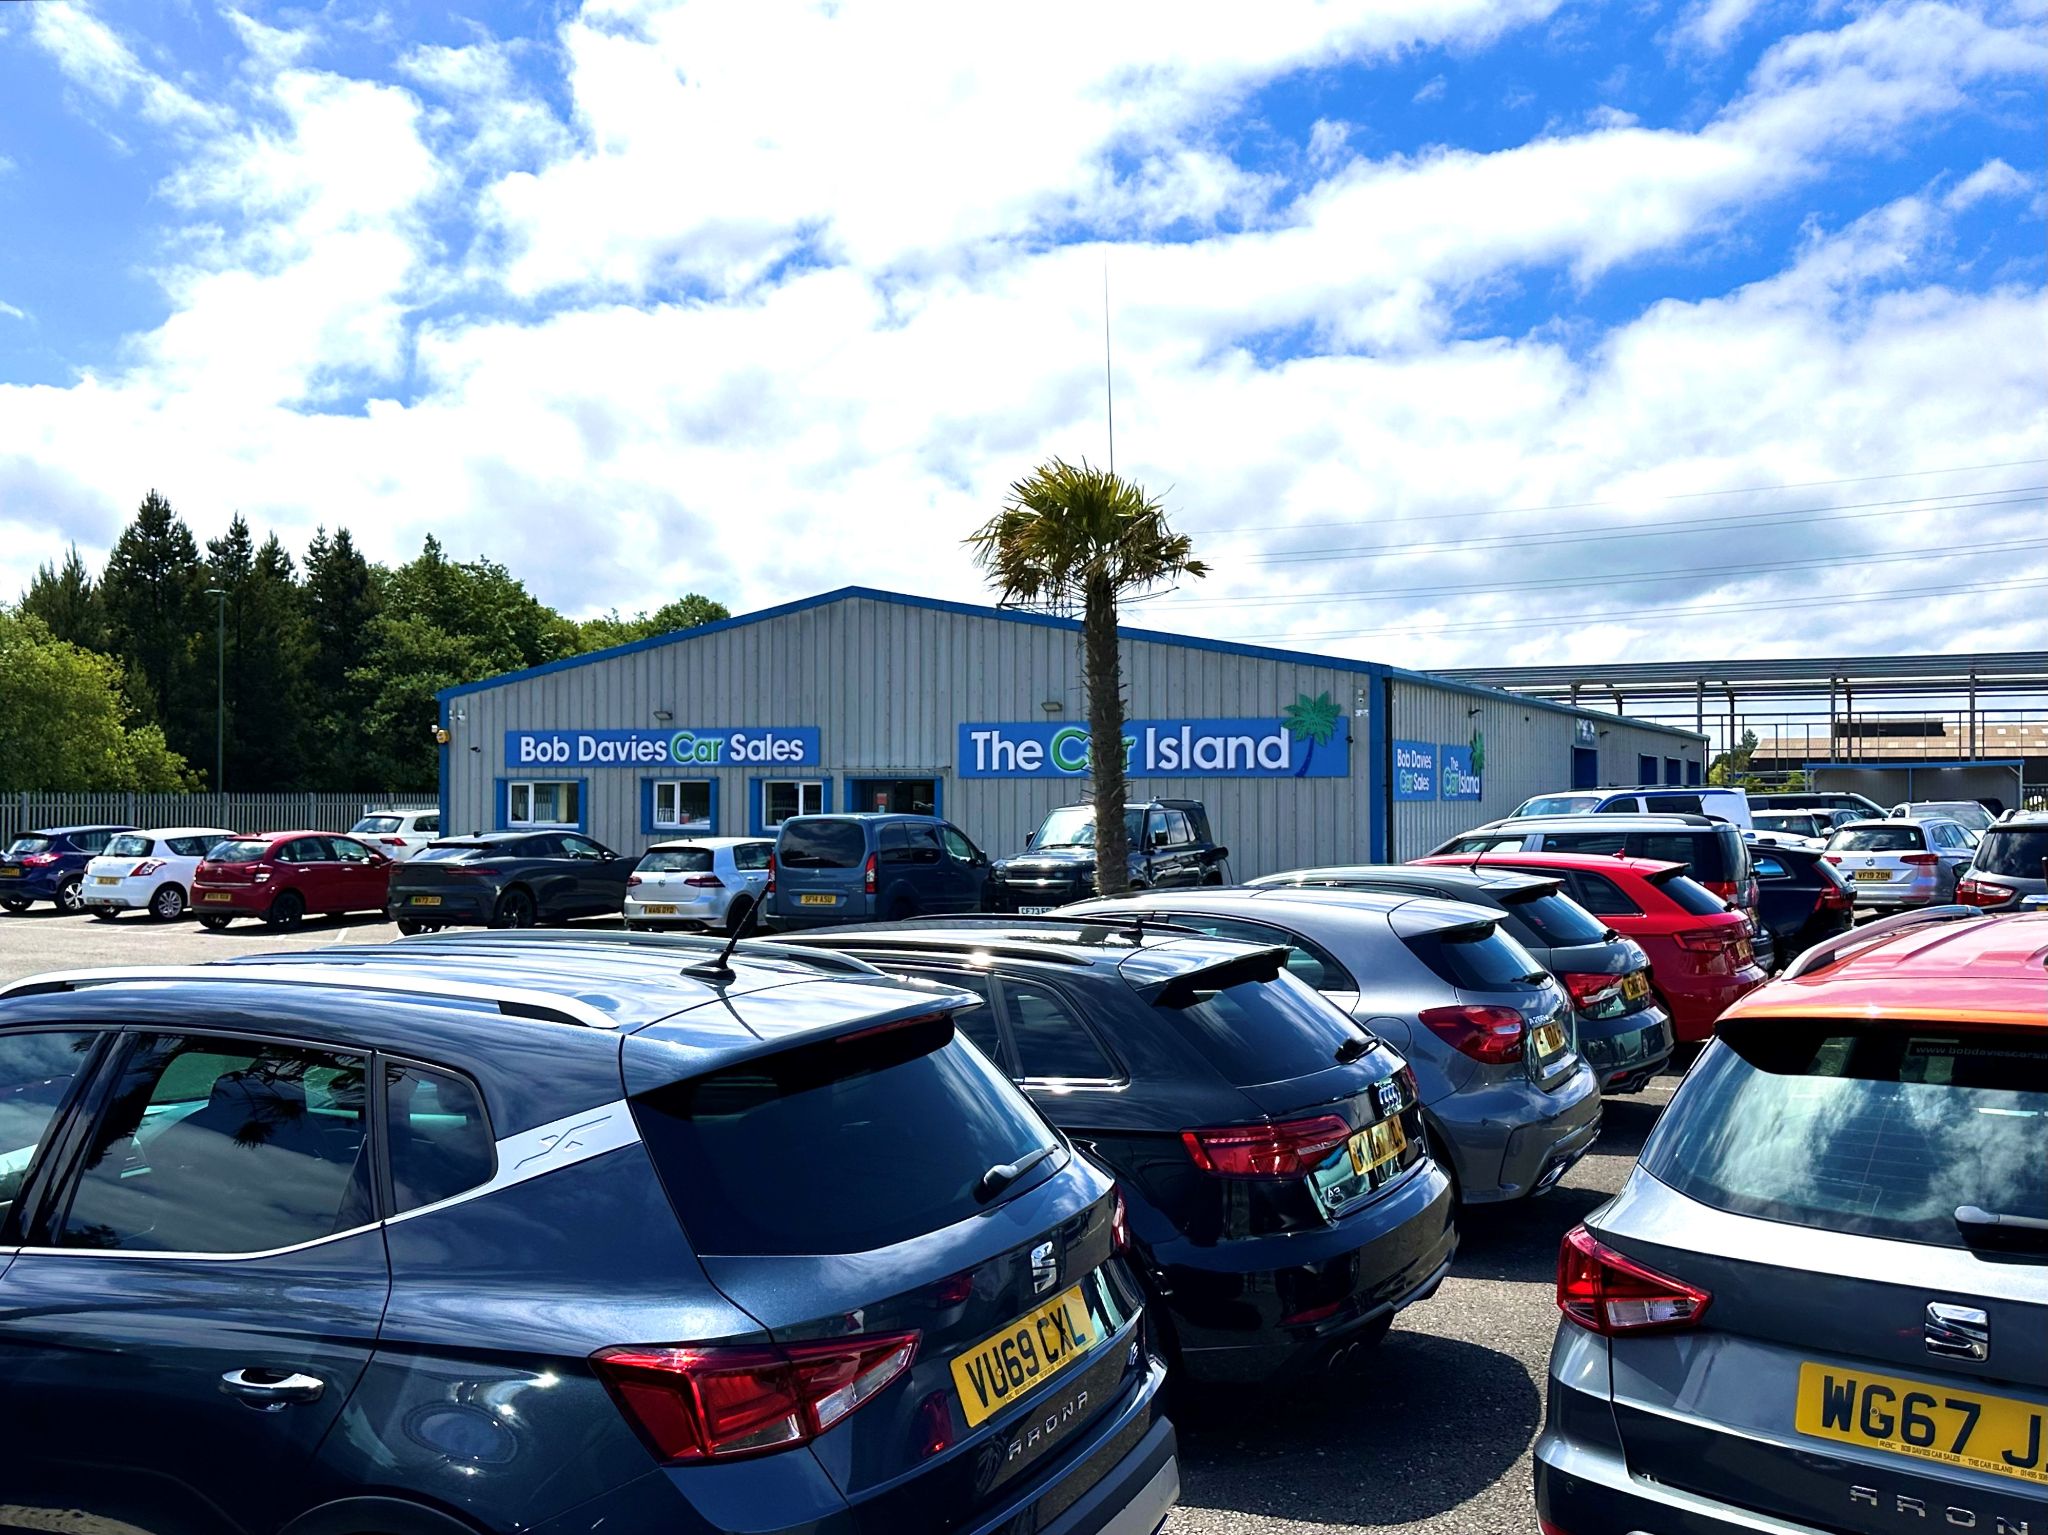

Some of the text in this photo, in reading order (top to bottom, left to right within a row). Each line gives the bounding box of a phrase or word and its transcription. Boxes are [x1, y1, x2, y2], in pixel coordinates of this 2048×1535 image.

[520, 732, 804, 763] Bob Davies Car Sales
[970, 726, 1290, 772] The Cr Island
[1397, 748, 1432, 768] Bob Davies
[1450, 757, 1459, 771] The
[1400, 769, 1430, 793] Car Sales
[1443, 767, 1480, 796] Car Island
[1857, 871, 1875, 879] VF19
[965, 1328, 1040, 1409] VU69
[1037, 1304, 1087, 1364] CXL
[1008, 1390, 1088, 1461] ARONA
[1822, 1374, 2048, 1473] WG67 J
[1911, 1446, 1932, 1457] DAVIES
[1931, 1451, 1943, 1459] CAR
[1943, 1453, 1961, 1463] SALES
[1968, 1458, 1980, 1467] THE
[1979, 1461, 1992, 1470] CAR
[1992, 1463, 2013, 1474] ISLAND
